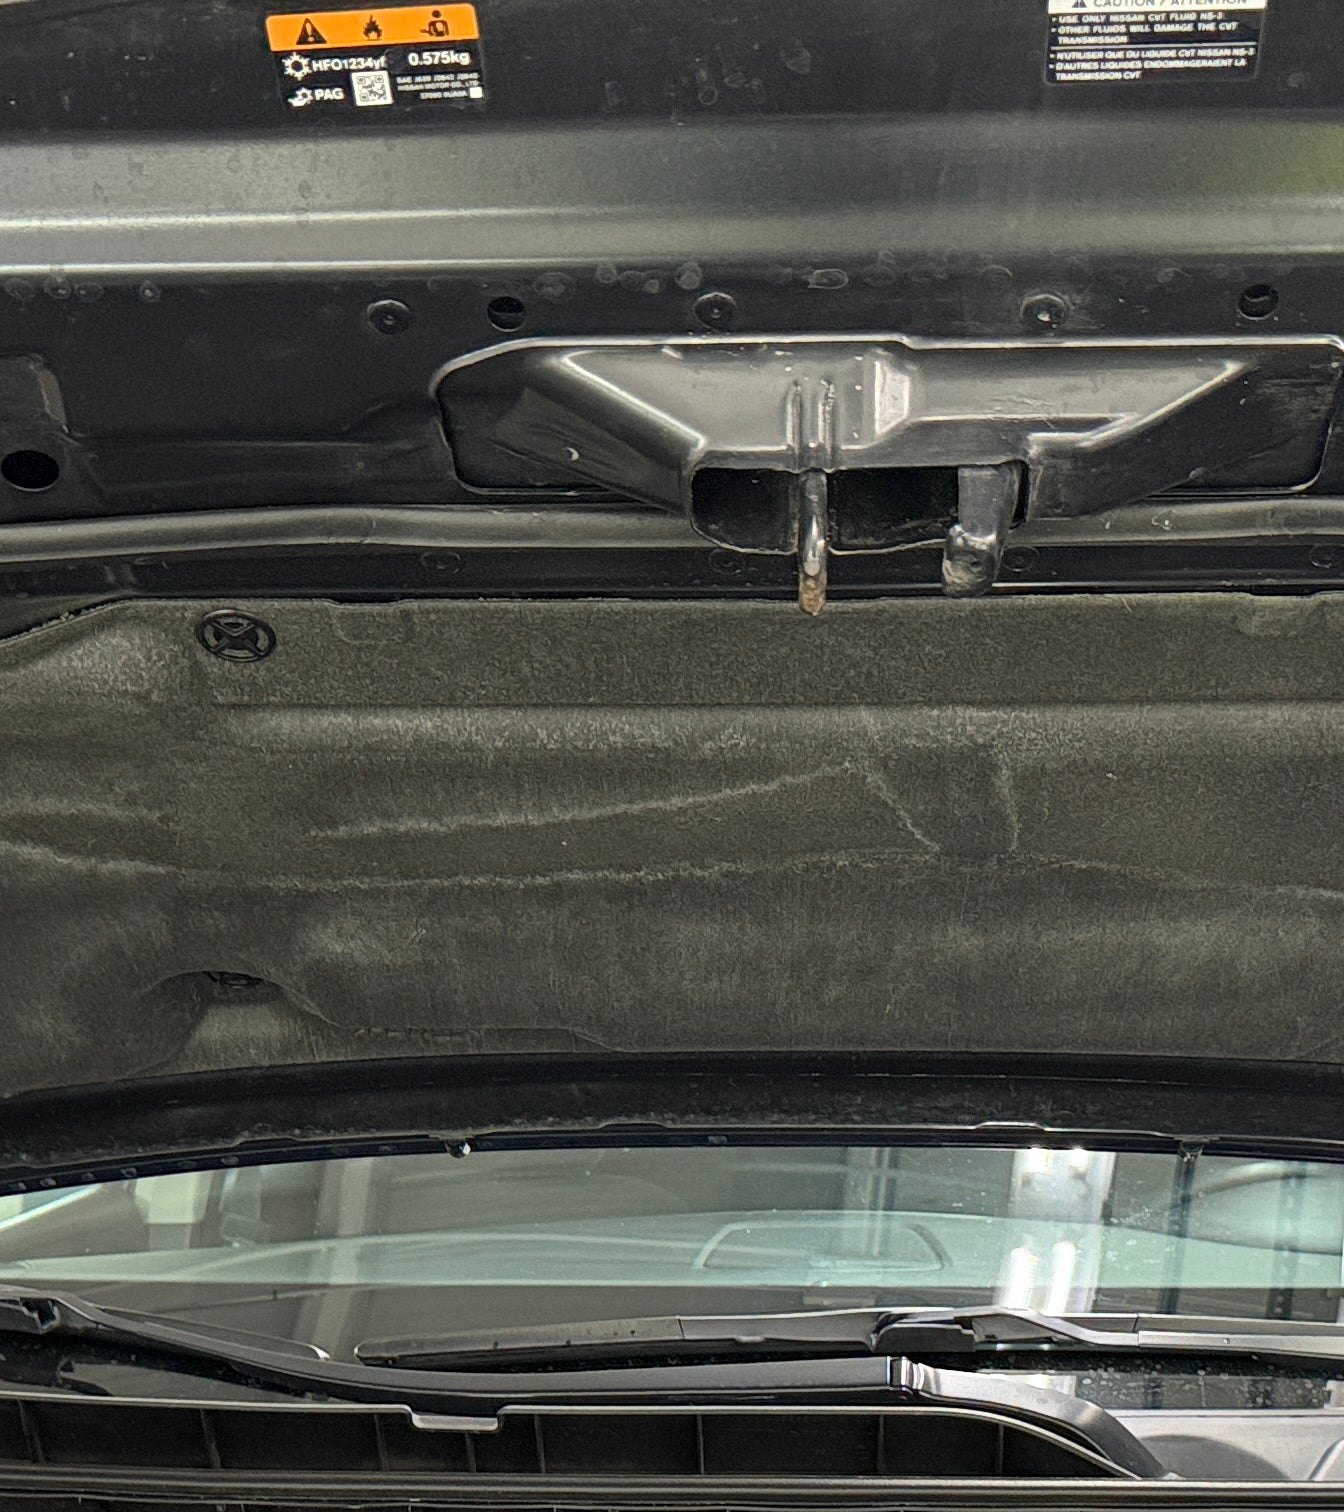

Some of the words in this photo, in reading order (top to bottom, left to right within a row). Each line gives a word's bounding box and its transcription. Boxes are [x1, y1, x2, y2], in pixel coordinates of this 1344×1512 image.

[1082, 15, 1106, 23] ONLY
[312, 55, 386, 71] HFO1234yf
[408, 51, 470, 66] 0.575kg
[314, 87, 344, 100] PAG
